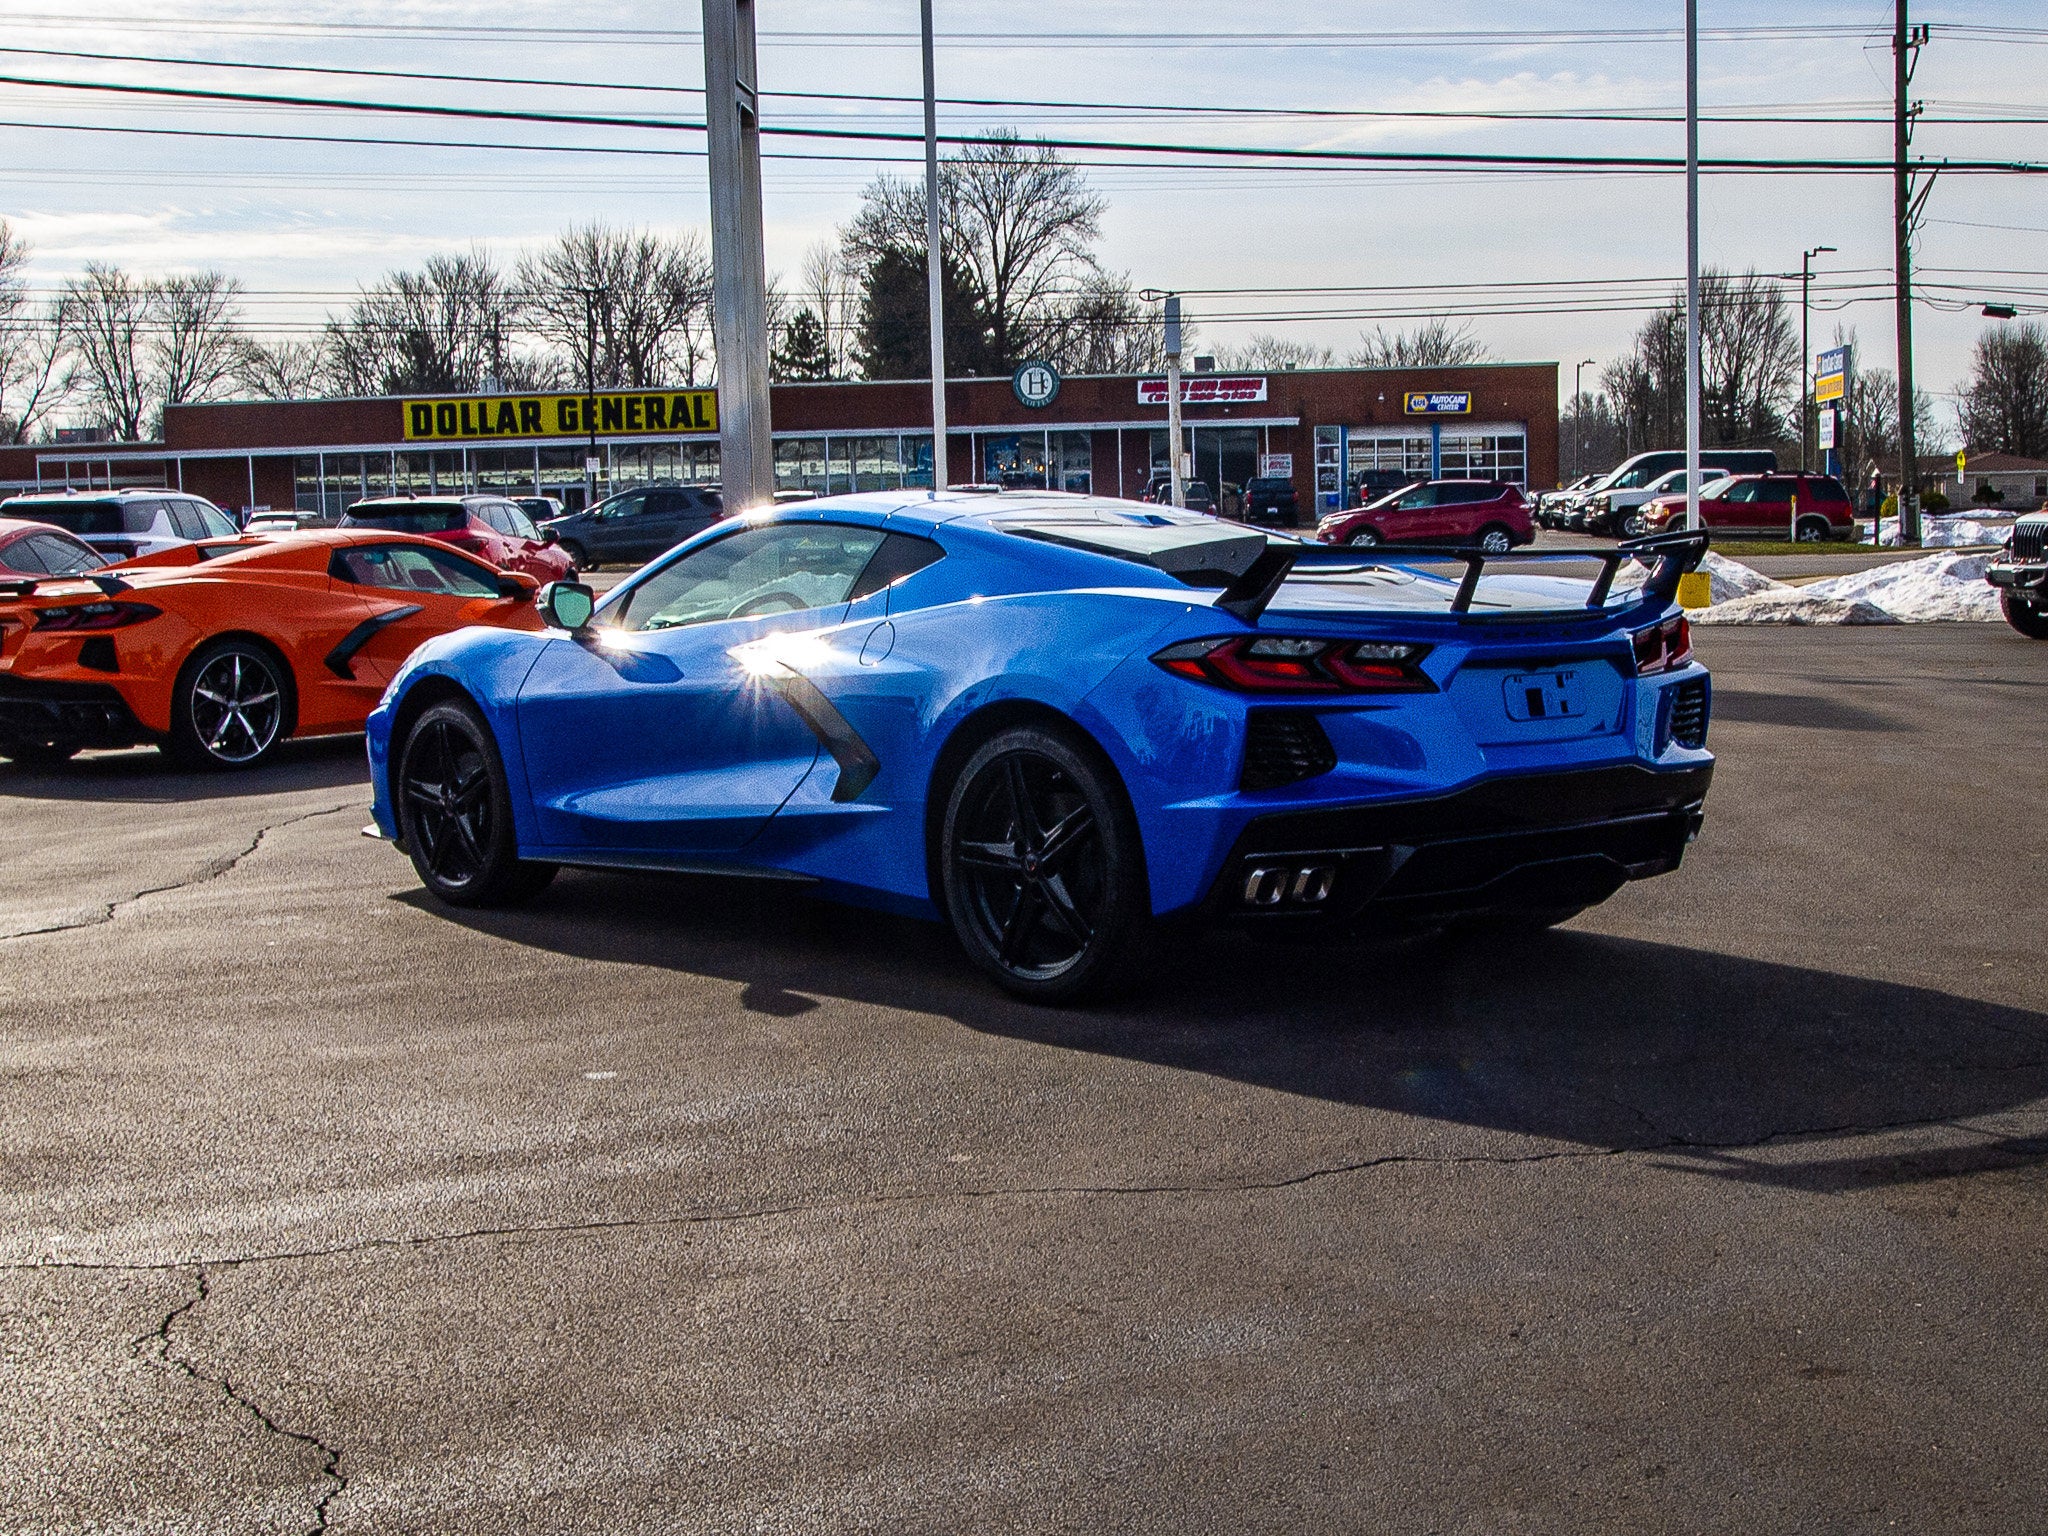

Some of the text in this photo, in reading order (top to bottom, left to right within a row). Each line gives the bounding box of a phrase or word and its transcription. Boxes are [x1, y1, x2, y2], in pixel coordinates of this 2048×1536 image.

[1190, 380, 1218, 392] AUTO
[1218, 379, 1263, 392] SERVICE
[1430, 395, 1467, 404] AUTOCARE
[1437, 403, 1459, 411] CENTER
[410, 394, 710, 437] DOLLAR GENERAL
